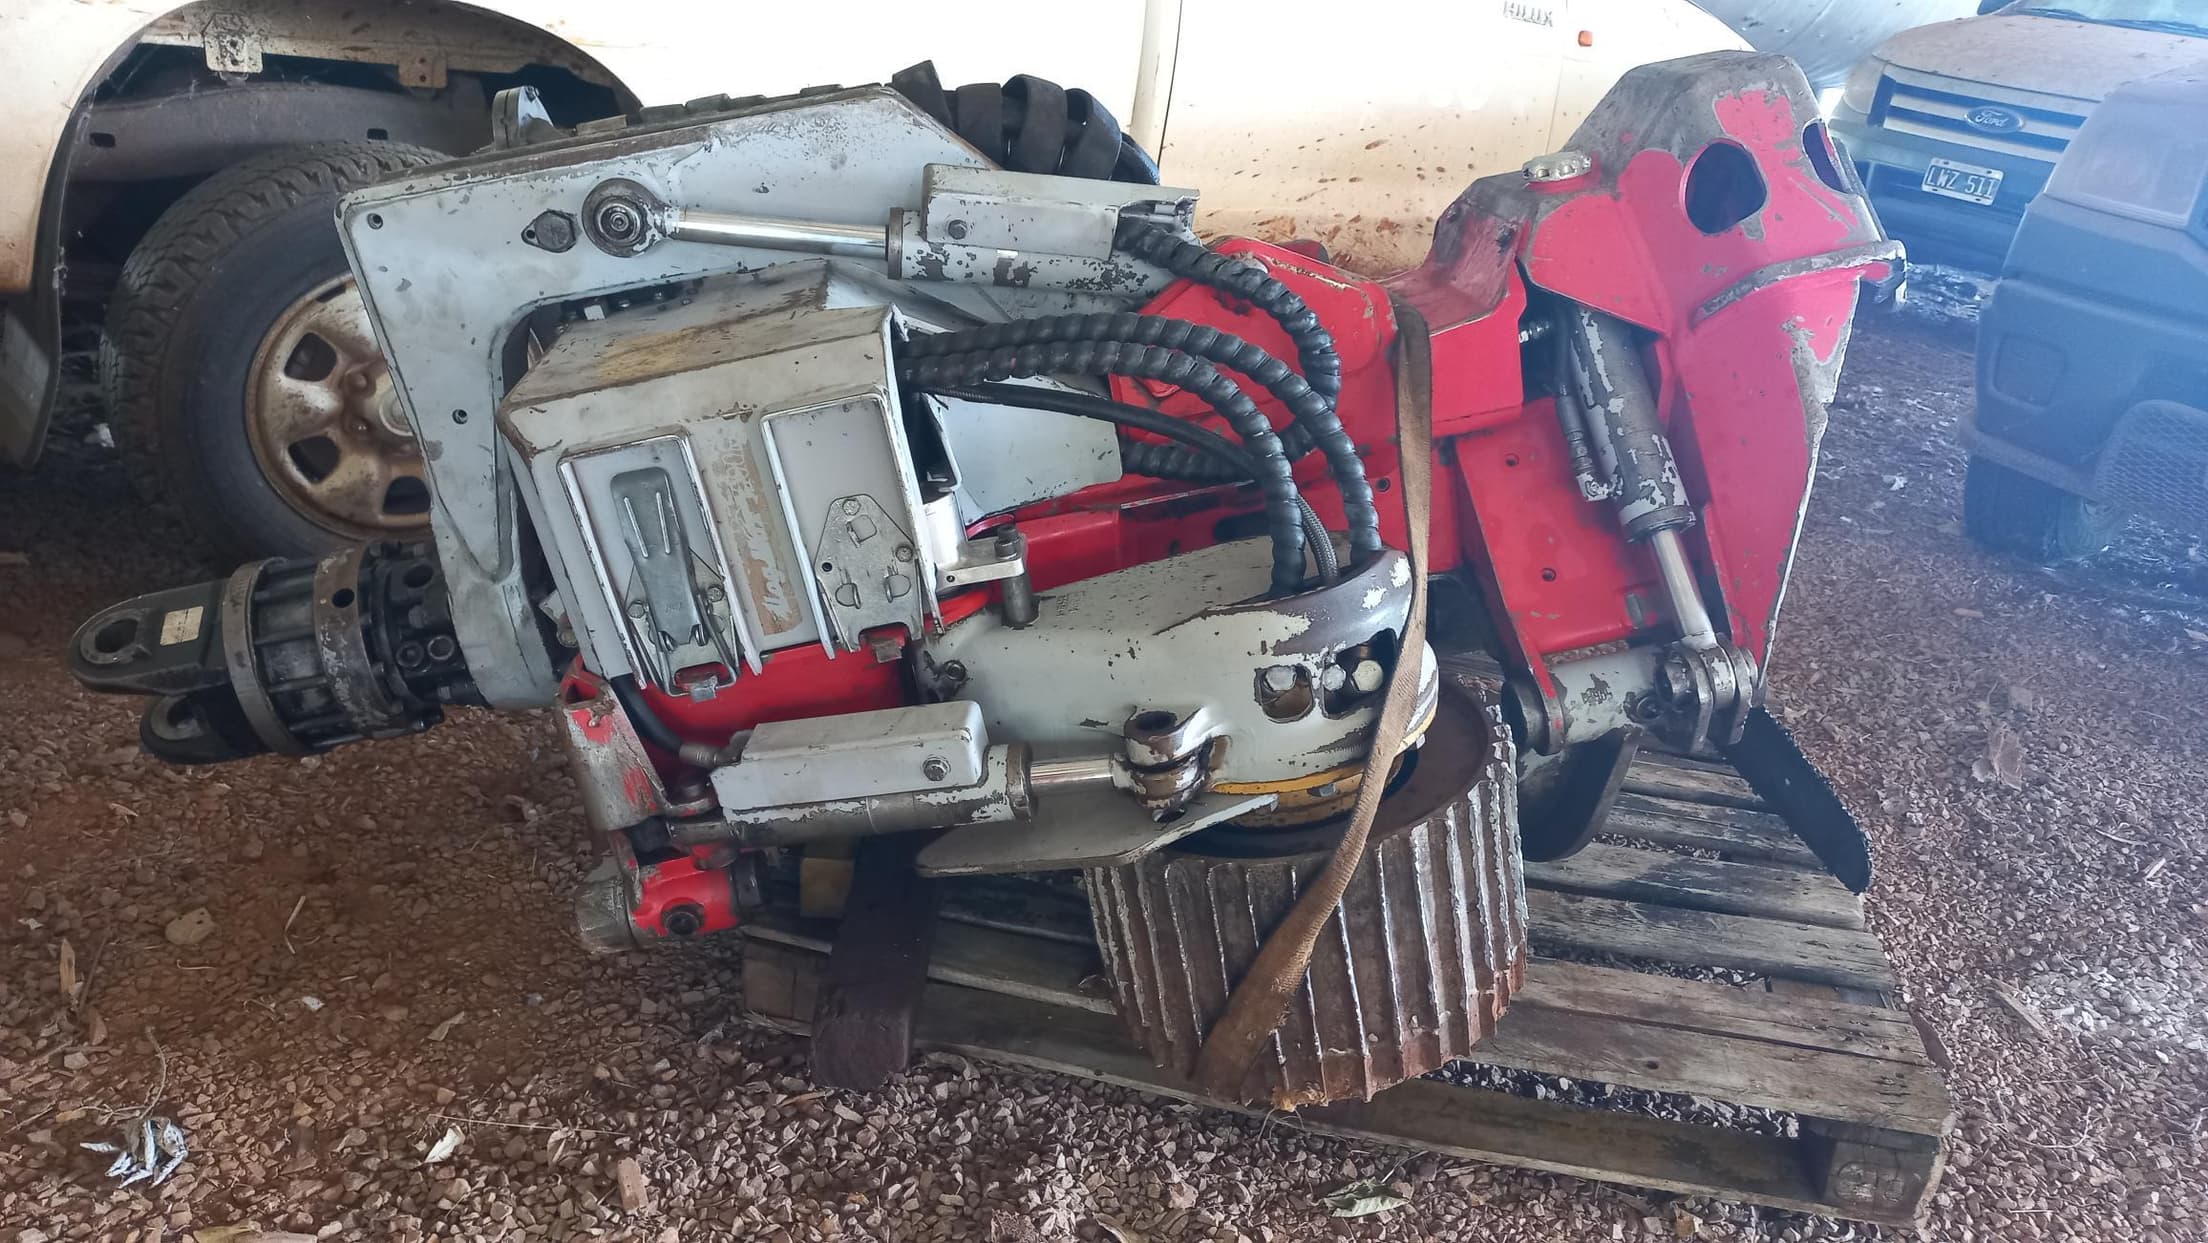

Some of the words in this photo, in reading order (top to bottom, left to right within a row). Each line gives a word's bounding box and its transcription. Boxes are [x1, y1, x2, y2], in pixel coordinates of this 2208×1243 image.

[1502, 0, 1553, 27] HILUX
[1975, 110, 2009, 127] Ford
[1926, 166, 1960, 189] LWZ
[1964, 175, 1996, 198] 511
